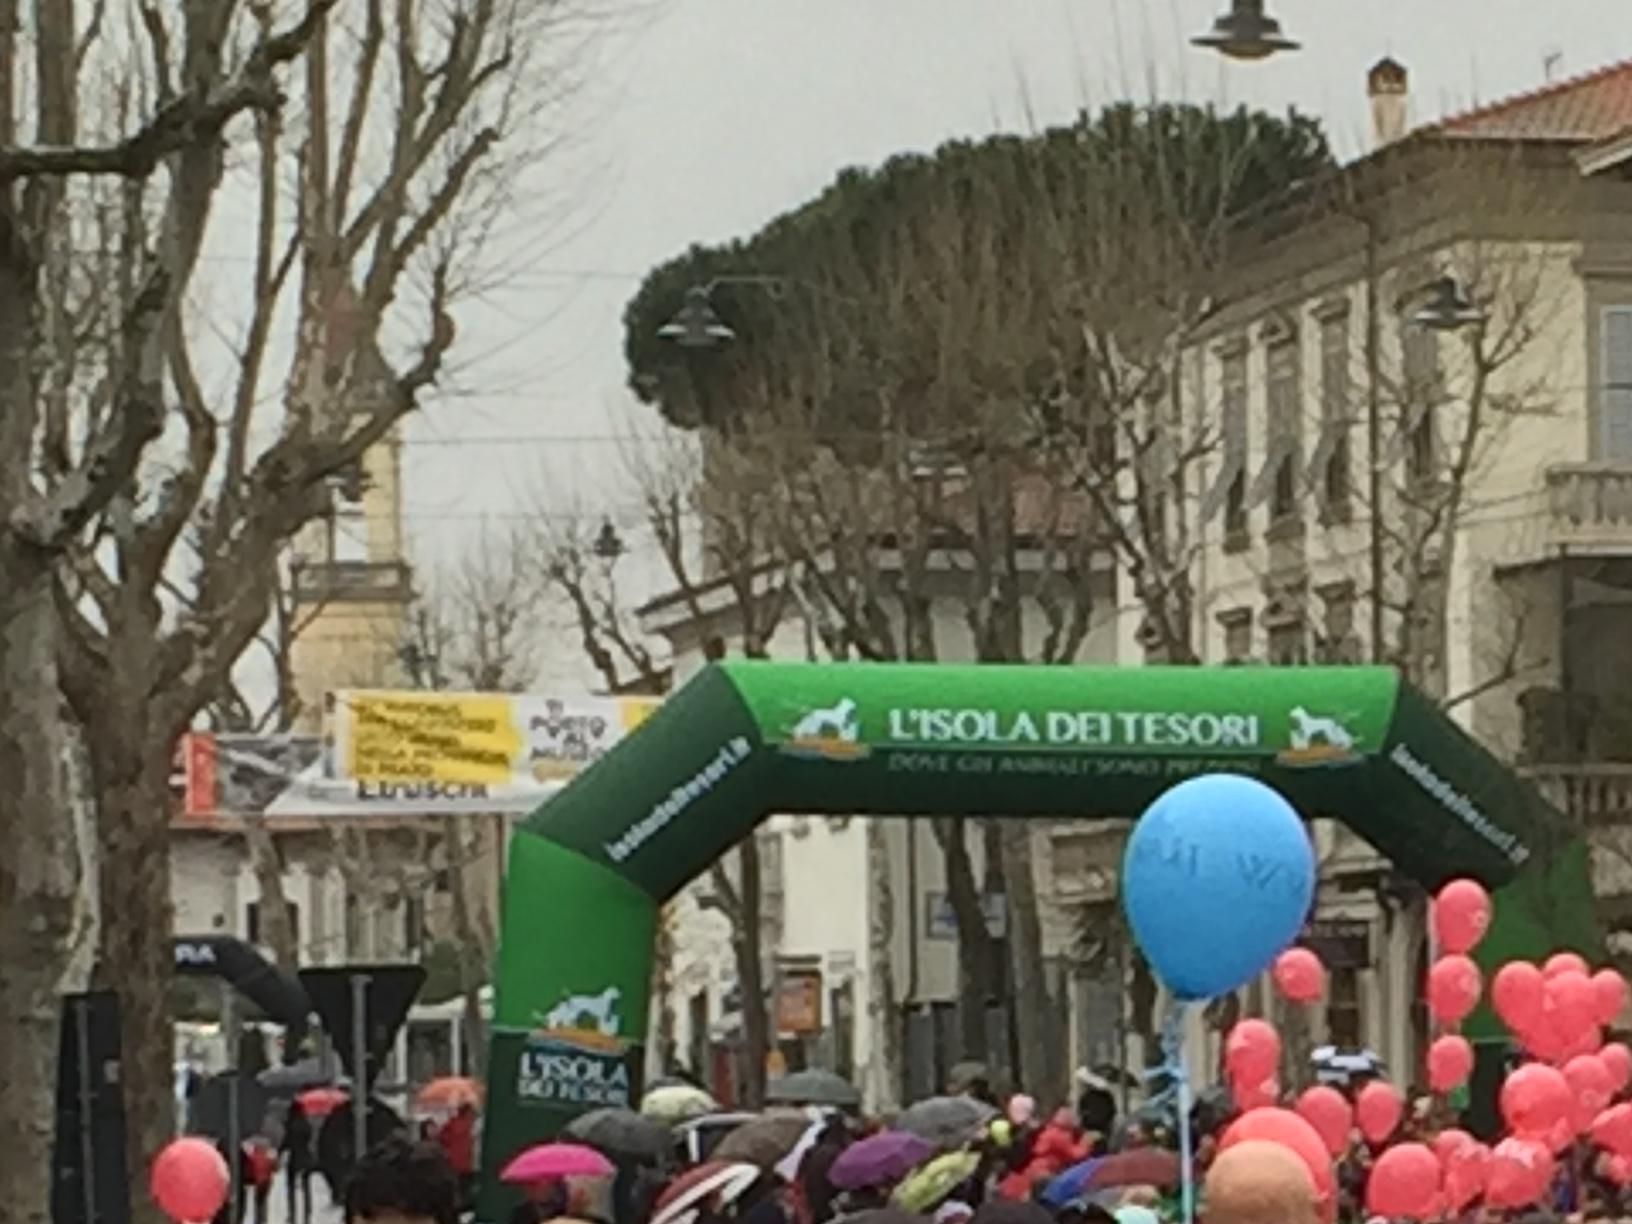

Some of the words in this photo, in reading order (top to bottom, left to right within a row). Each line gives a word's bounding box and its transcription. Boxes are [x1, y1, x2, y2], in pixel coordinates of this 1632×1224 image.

[888, 709, 1040, 743] L'ISOLA
[1046, 713, 1112, 744] DEI
[1114, 715, 1259, 746] TESORI
